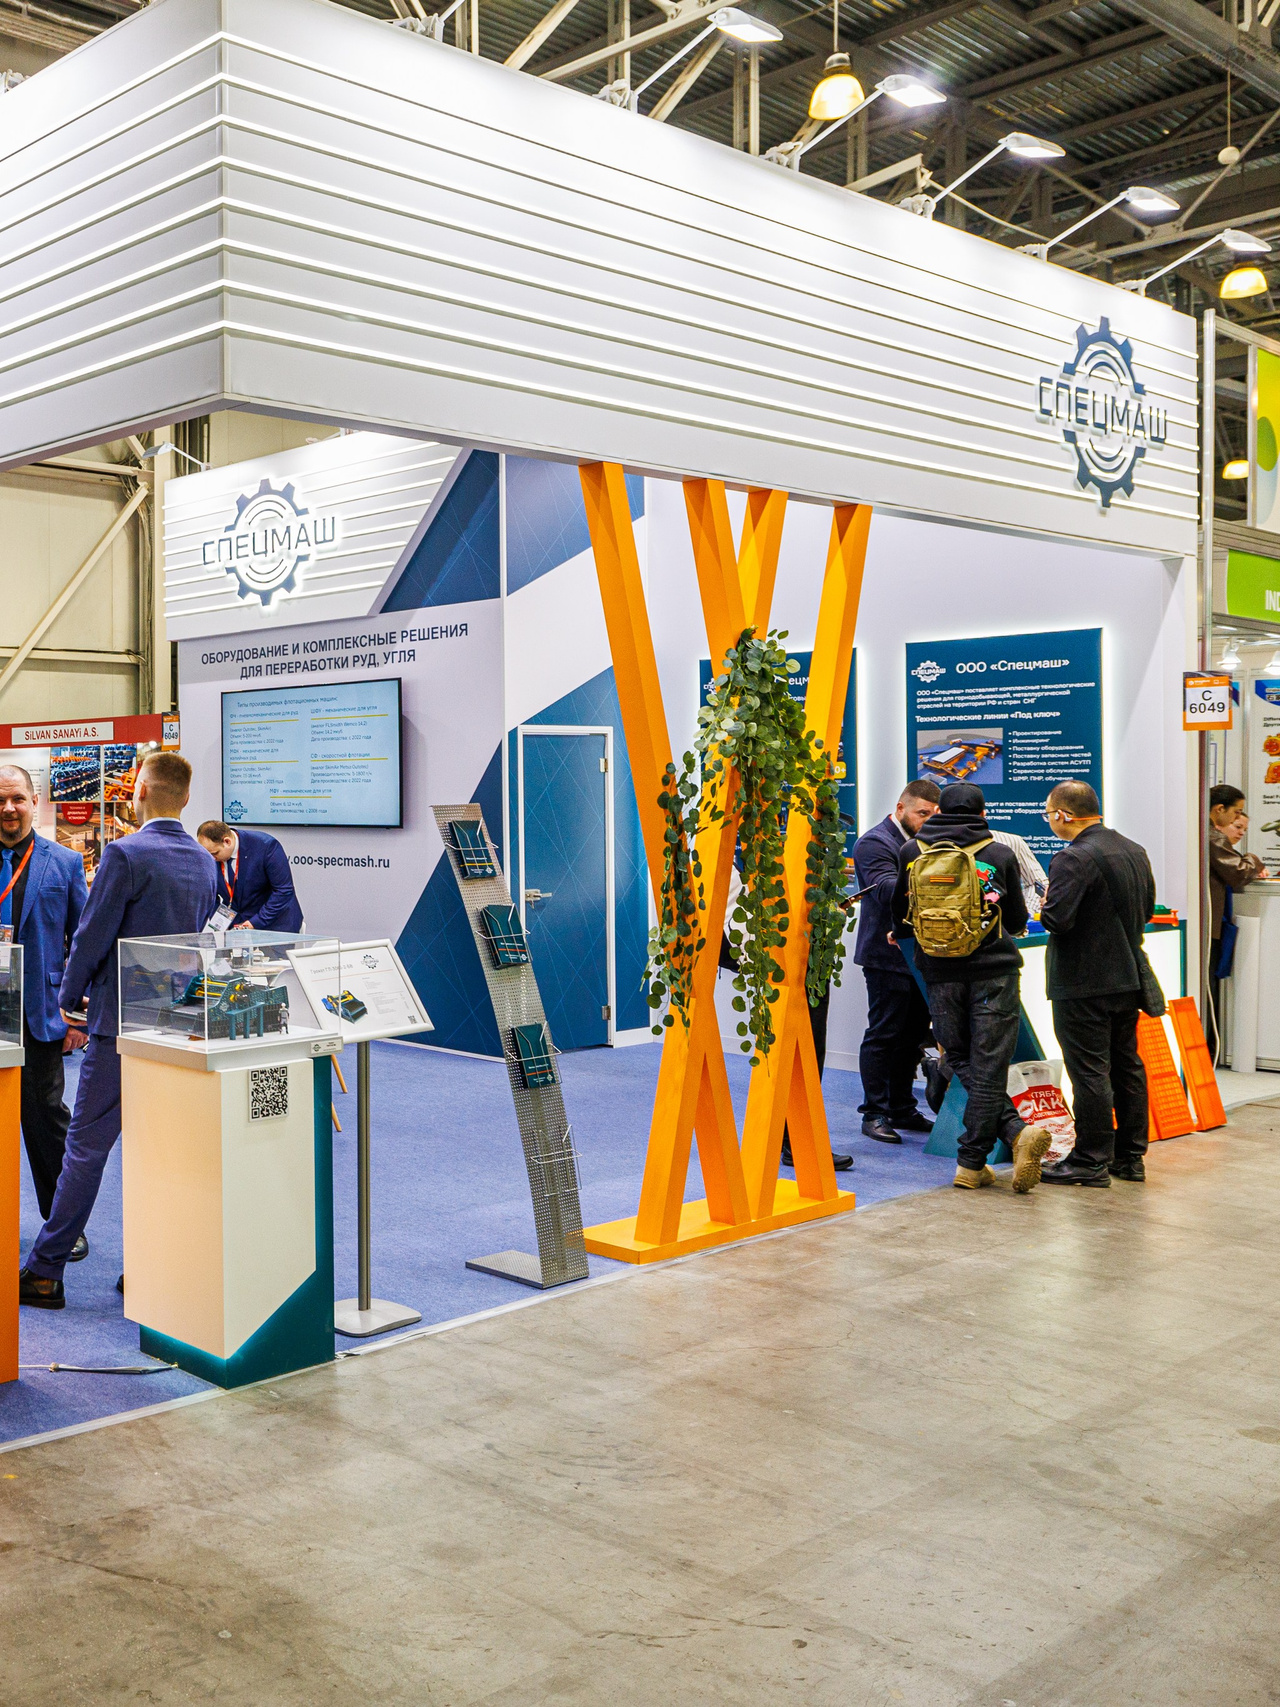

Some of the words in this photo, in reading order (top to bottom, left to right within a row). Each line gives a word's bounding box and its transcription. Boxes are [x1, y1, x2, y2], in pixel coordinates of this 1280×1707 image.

[1039, 376, 1167, 444] СПЕЦМАШ
[202, 516, 336, 566] СПЕЦМАШ
[201, 644, 289, 665] ОБОРУДОВАНИЕ
[292, 643, 300, 655] И
[303, 631, 397, 654] КОМПЛЕКСНЫЕ
[400, 623, 469, 643] РЕШЕНИЯ
[240, 665, 263, 680] ДЛЯ
[266, 655, 349, 676] ПЕРЕРАБОТКИ
[352, 653, 380, 669] РУД,
[383, 649, 416, 665] УГЛЯ
[956, 661, 987, 674] ООО
[990, 659, 1070, 672] «Спецмаш»
[911, 668, 946, 676] СПЕЦМАШ
[999, 684, 1040, 692] комплексные
[1041, 681, 1095, 689] технологические
[1190, 702, 1225, 713] 6049
[915, 714, 982, 723] Технологические
[1010, 711, 1032, 719] «Под
[164, 732, 178, 740] 6049
[288, 855, 390, 868] .ooo-specmash.ru
